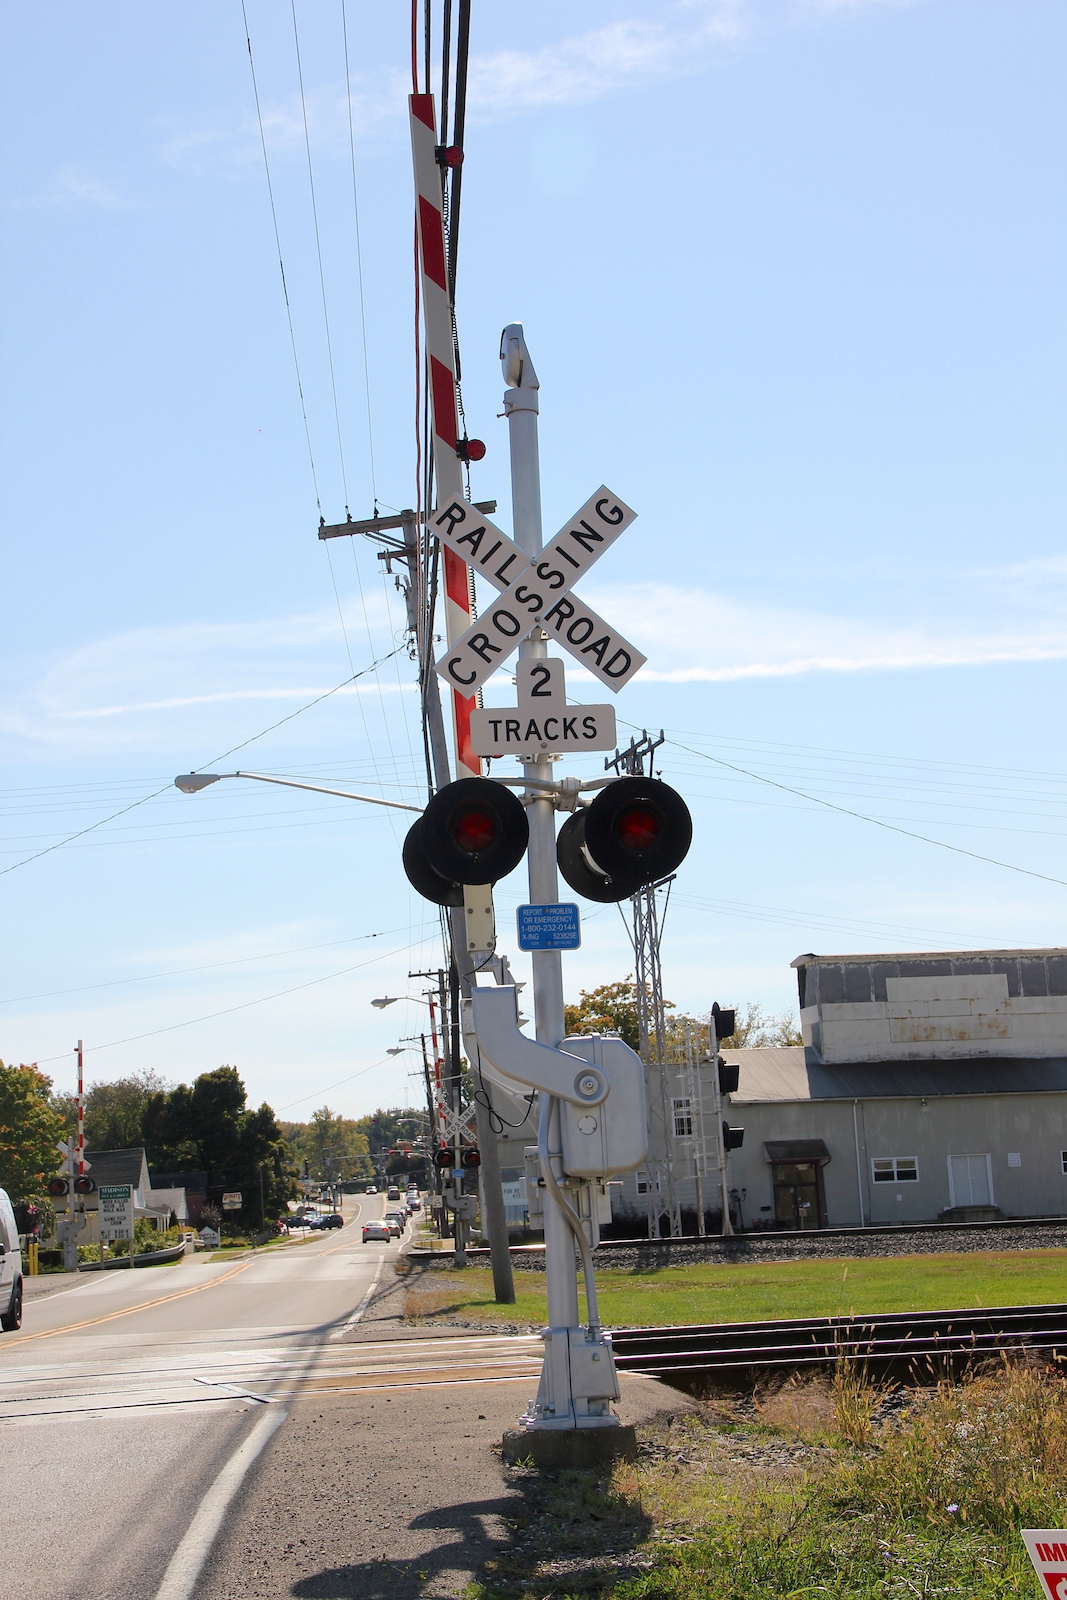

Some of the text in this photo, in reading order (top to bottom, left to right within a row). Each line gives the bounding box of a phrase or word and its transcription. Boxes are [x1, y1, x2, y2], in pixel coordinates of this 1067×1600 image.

[435, 501, 632, 679] RAIL ROAD
[447, 498, 624, 685] CROSSING
[530, 666, 552, 697] 2
[488, 716, 597, 742] TRACKS
[521, 924, 576, 932] 1-800-232-0144
[441, 1106, 475, 1142] RAIL ROAD
